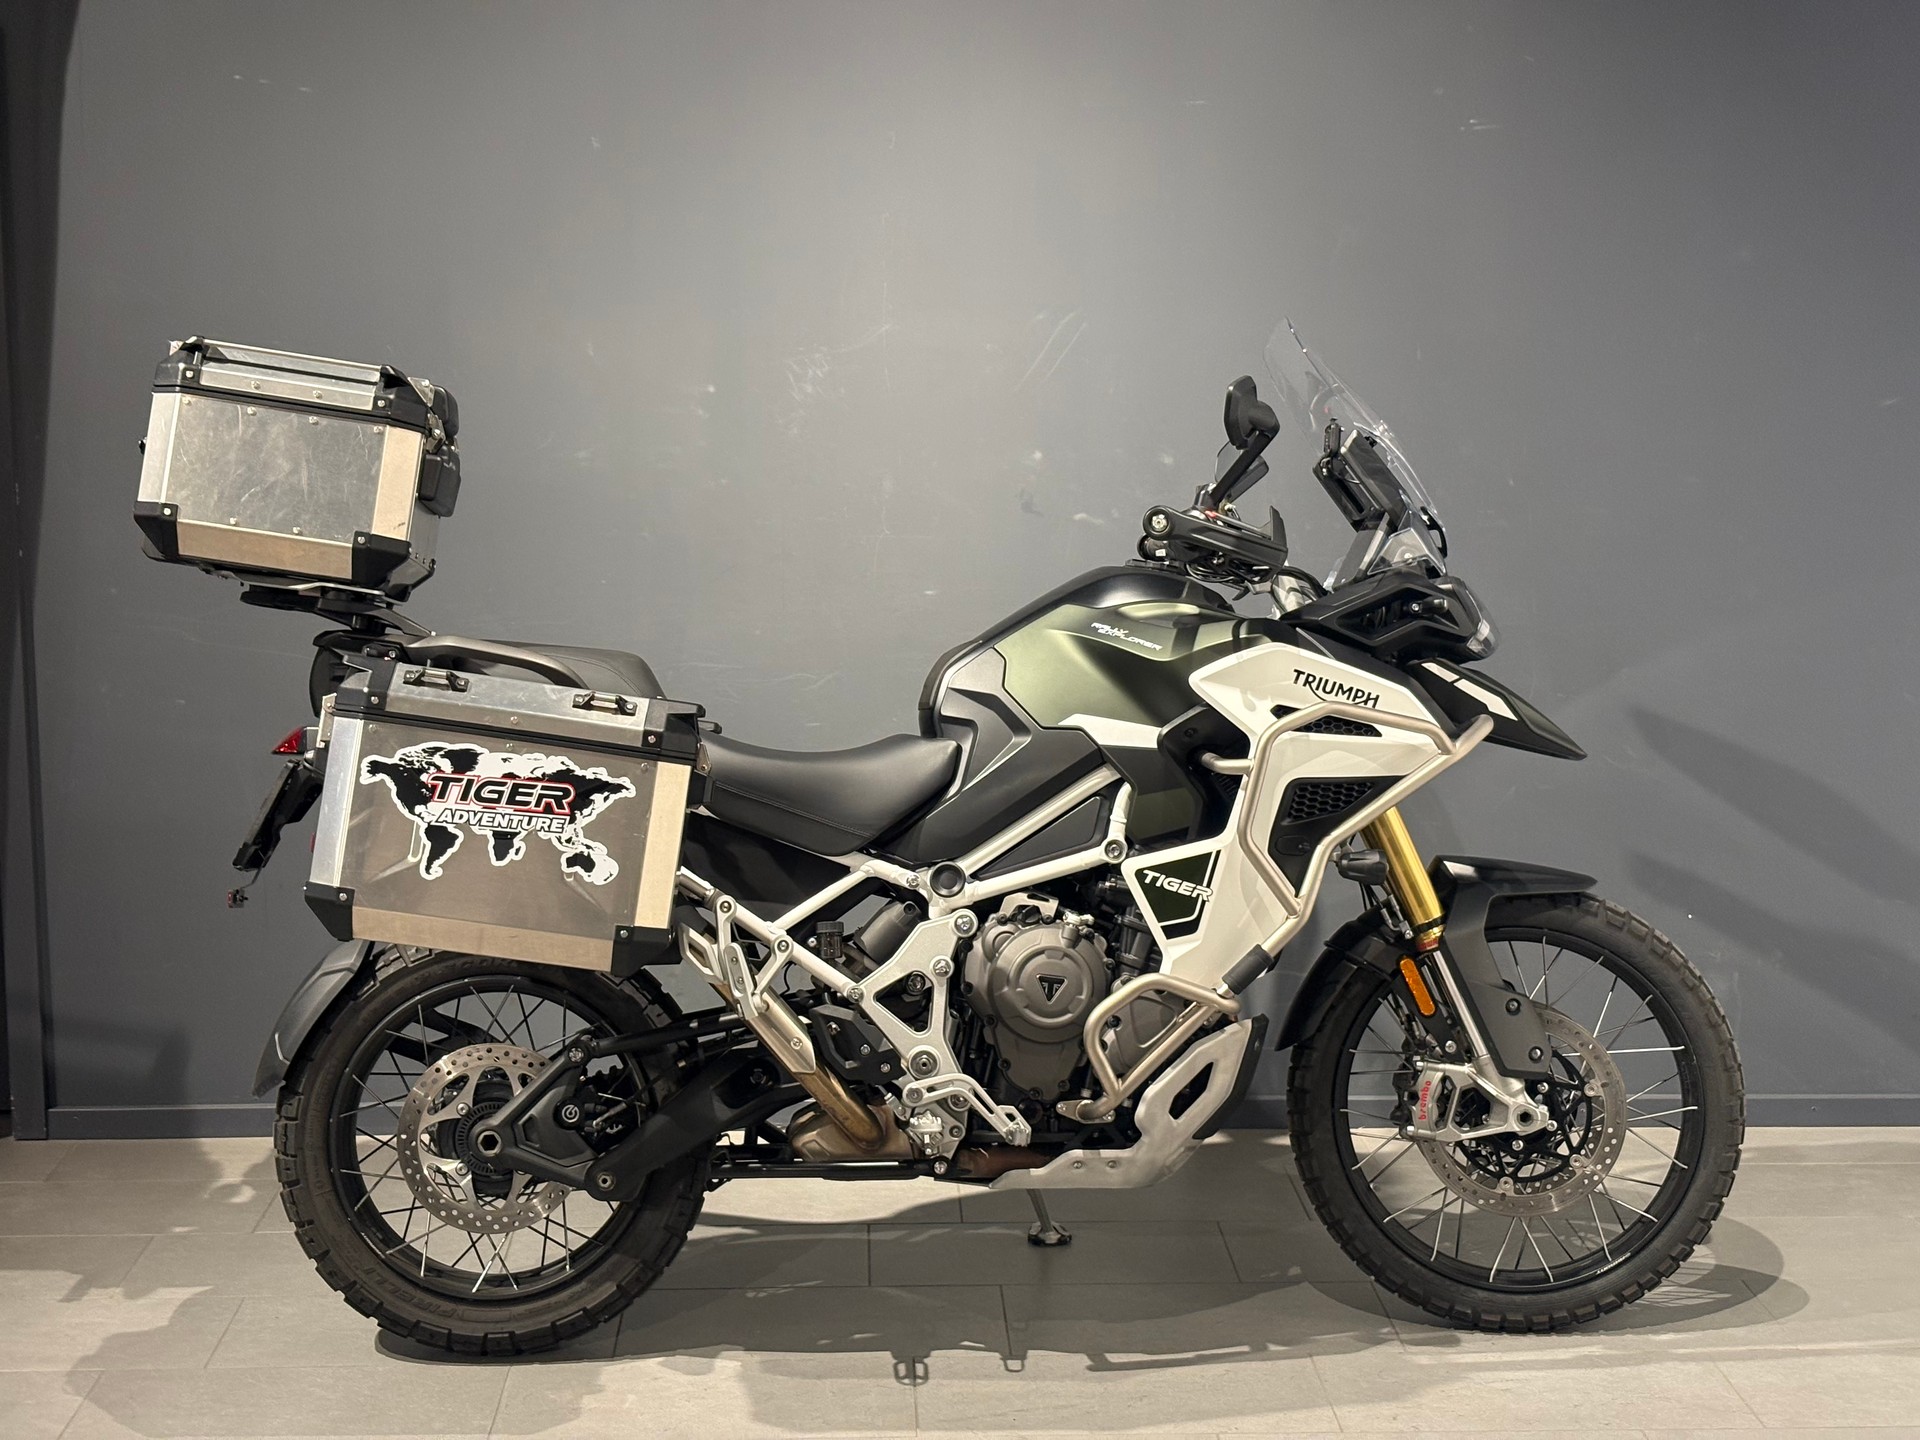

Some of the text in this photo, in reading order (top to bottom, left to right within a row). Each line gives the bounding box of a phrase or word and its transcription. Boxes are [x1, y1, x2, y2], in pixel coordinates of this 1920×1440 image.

[1293, 669, 1380, 709] TRIUMPH
[429, 773, 575, 813] TIGER
[433, 808, 567, 833] ADVENTURE
[1142, 869, 1214, 902] TIGER
[1418, 1080, 1432, 1120] brembo
